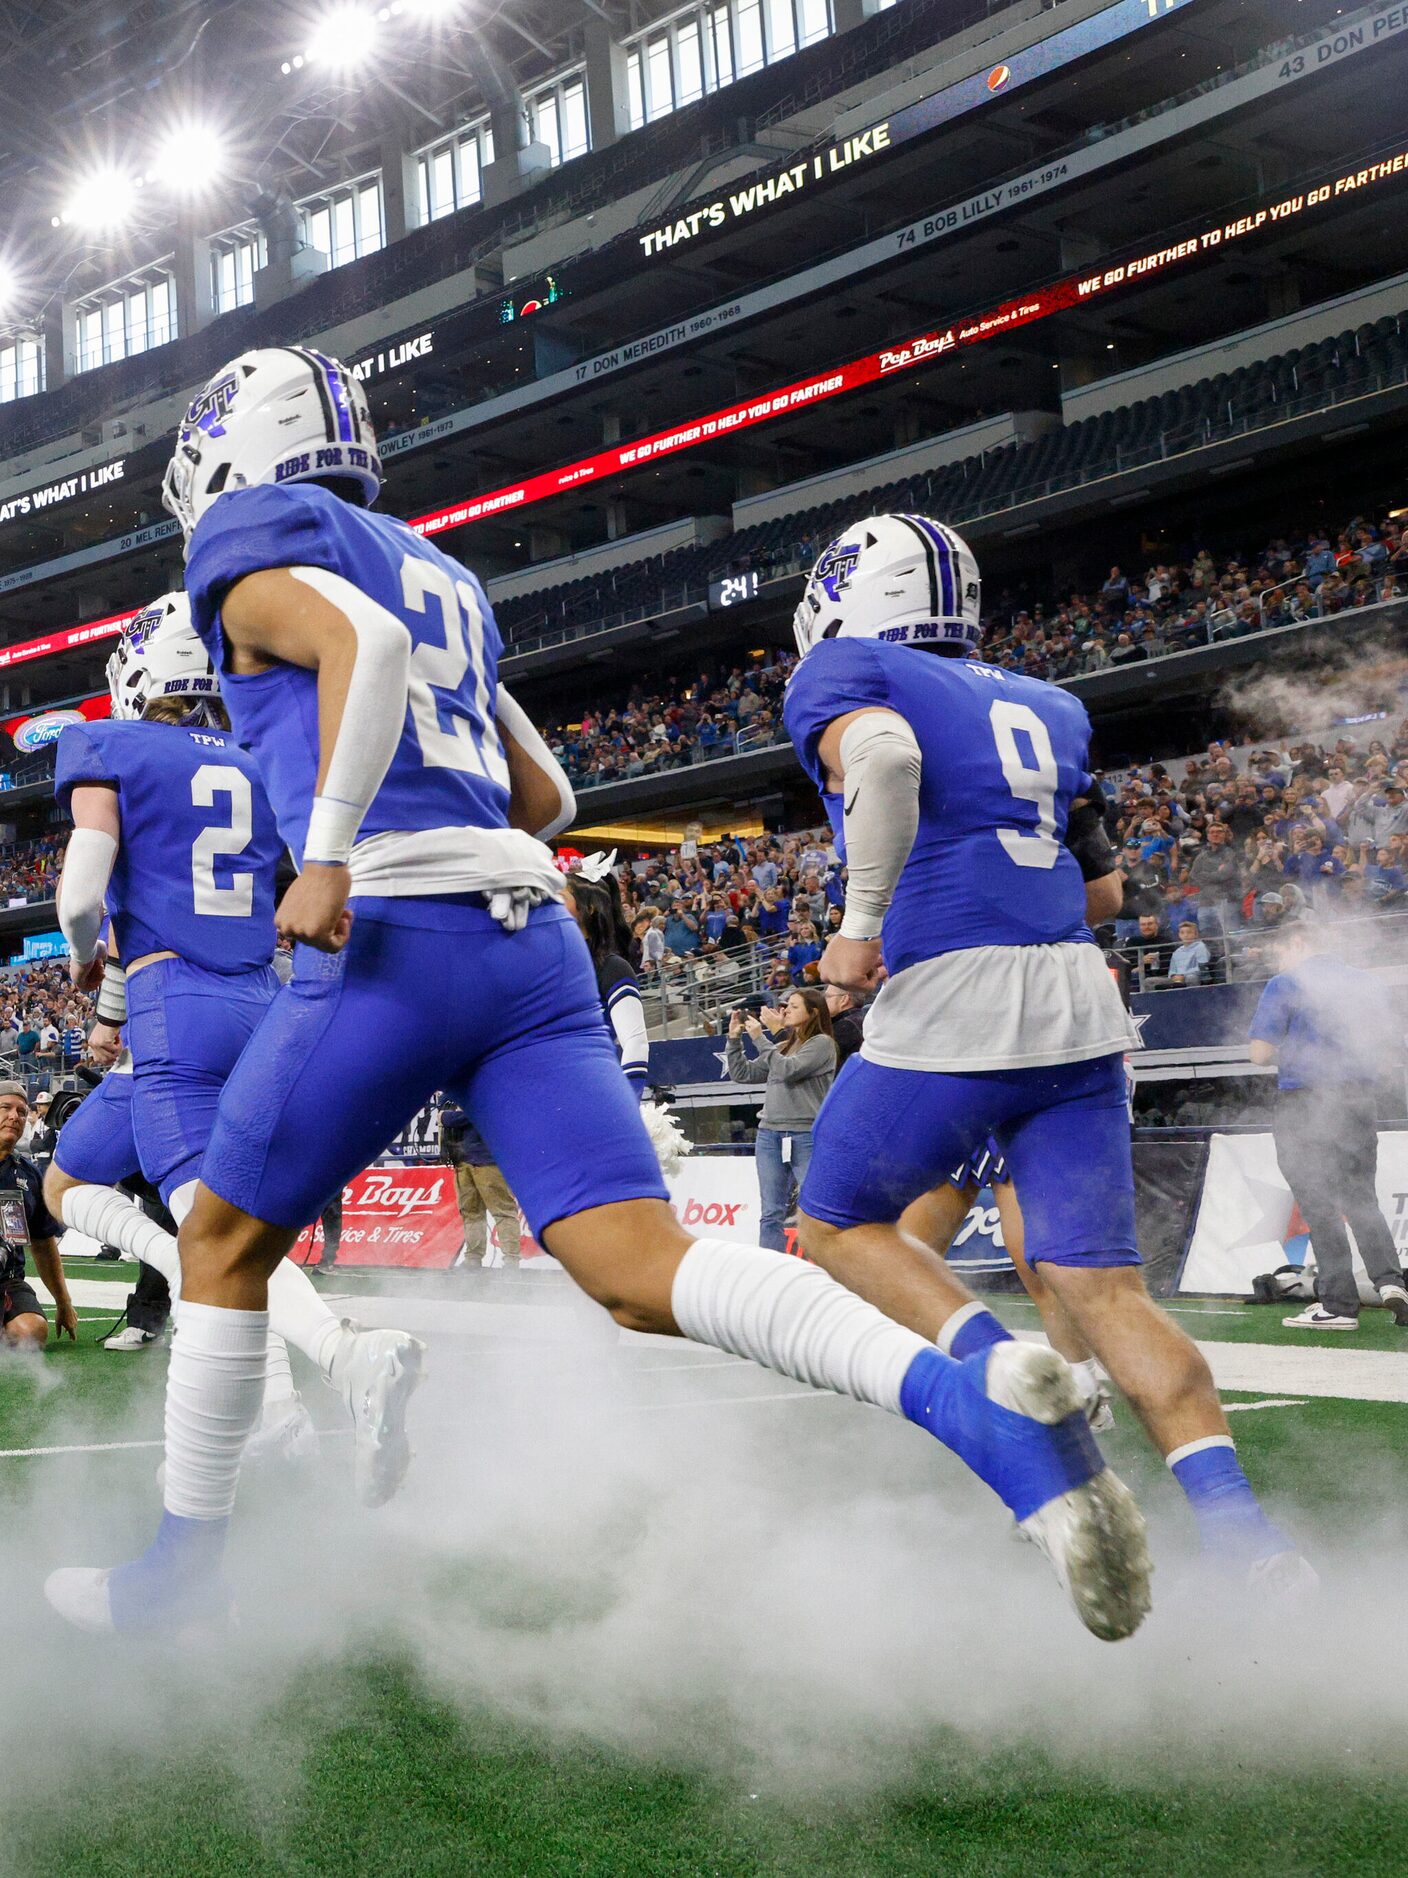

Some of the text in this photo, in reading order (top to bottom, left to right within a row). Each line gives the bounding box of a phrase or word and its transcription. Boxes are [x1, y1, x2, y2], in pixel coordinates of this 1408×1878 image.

[1278, 6, 1408, 79] 43 DON PE
[639, 122, 891, 257] THAT'S WHAT I LIKE
[896, 163, 1069, 248] 74 BOB LILLY 1961-1974
[1078, 277, 1101, 297] WE
[1103, 268, 1125, 286] GO
[1126, 239, 1197, 278] FURTHER
[1200, 231, 1222, 249] TO
[1224, 211, 1267, 240] HELP
[1269, 198, 1304, 222] YOU
[1307, 186, 1331, 207] GO
[344, 333, 433, 382] AT I LIKE
[575, 304, 742, 381] 17 DON MEREDITH 1960-1968
[879, 346, 913, 370] Pep
[912, 330, 956, 361] Boys
[959, 324, 980, 339] Auto
[979, 314, 1011, 336] Service
[1017, 302, 1041, 320] Tires
[417, 419, 454, 441] 1961-1973
[619, 375, 843, 464] WE GO FURTHER TO HELP YOU GO FARTHER
[32, 479, 78, 509] WHAT
[80, 475, 87, 493] I
[90, 461, 125, 489] LIKE
[275, 453, 311, 483] RIDE
[315, 448, 342, 468] FOR
[348, 448, 369, 469] THE
[425, 516, 449, 533] HELP
[449, 508, 468, 524] YOU
[468, 504, 482, 518] GO
[482, 490, 525, 513] FARTHER
[120, 538, 132, 550] 20
[135, 531, 153, 545] MEL
[878, 625, 908, 642] RIDE
[914, 622, 939, 639] FOR
[164, 678, 213, 694] RIDE FOR
[400, 553, 511, 794] 21
[33, 721, 65, 743] Ford
[189, 732, 226, 747] TPW
[989, 699, 1060, 869] 9
[191, 764, 254, 917] 2
[358, 1175, 445, 1218] Boys
[367, 1226, 381, 1243] &
[381, 1225, 424, 1244] Tires
